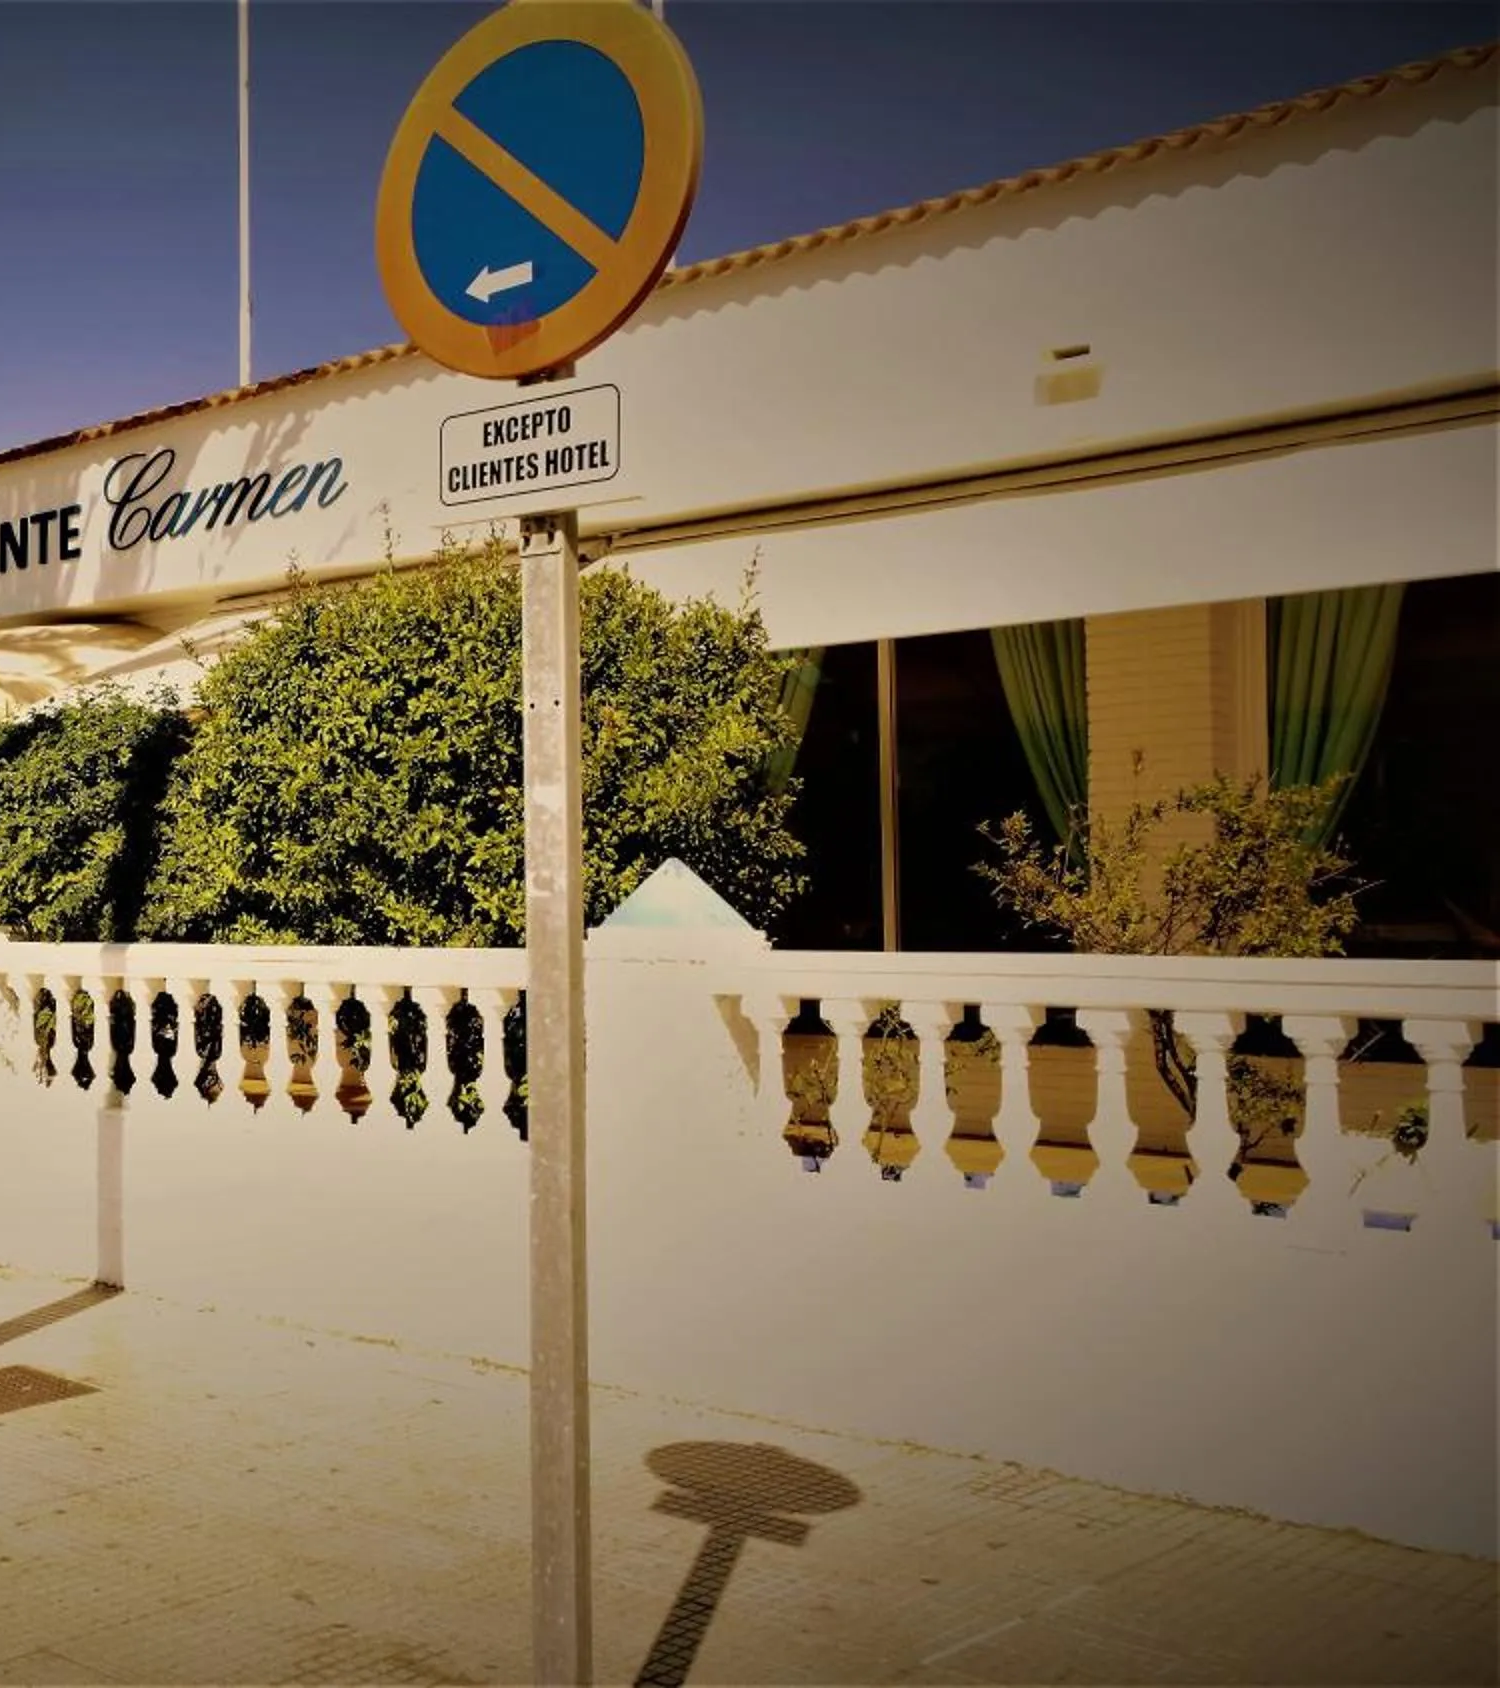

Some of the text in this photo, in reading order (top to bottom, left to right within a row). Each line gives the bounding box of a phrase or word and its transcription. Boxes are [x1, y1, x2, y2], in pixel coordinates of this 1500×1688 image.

[483, 406, 571, 447] EXCEPTO
[448, 440, 609, 493] CLIENTES HOTEL
[103, 448, 348, 551] Carmen
